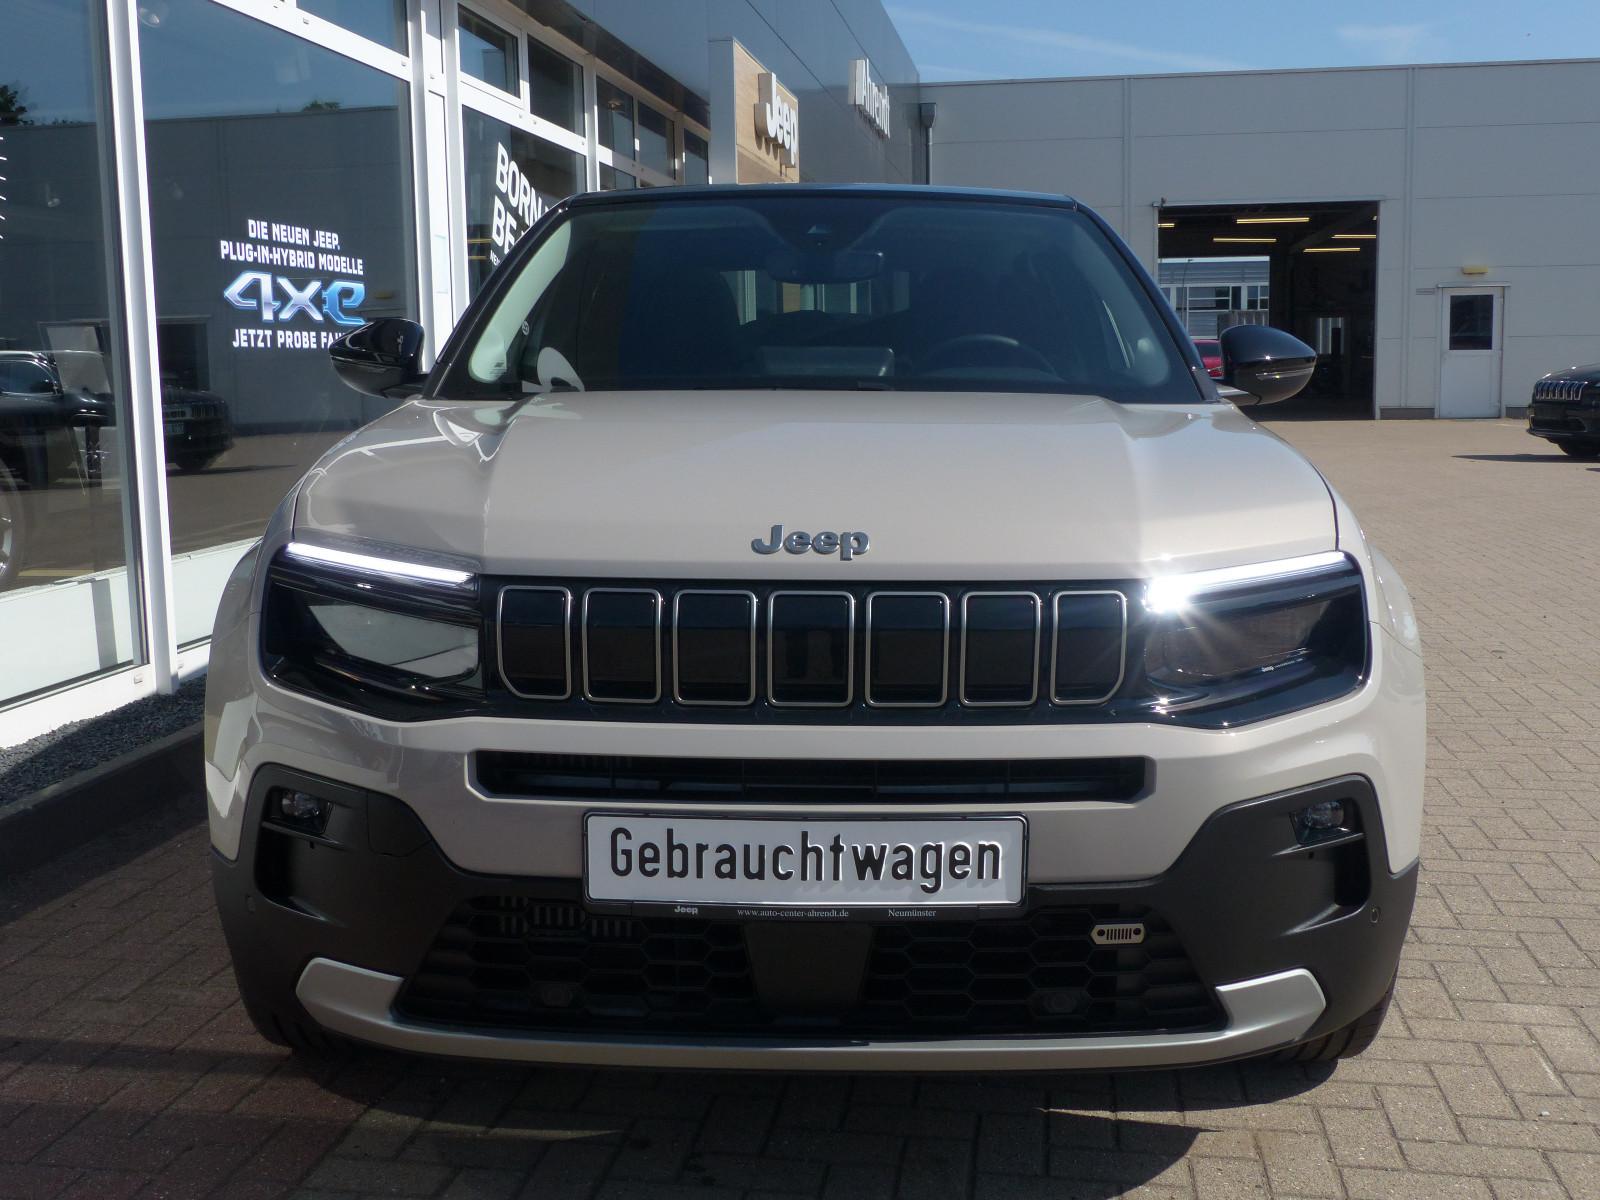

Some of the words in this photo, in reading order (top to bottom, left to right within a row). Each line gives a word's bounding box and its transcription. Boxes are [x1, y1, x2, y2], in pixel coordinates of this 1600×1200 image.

[762, 72, 798, 166] Jeep
[495, 141, 542, 229] BORN
[247, 218, 268, 240] DIE
[271, 222, 310, 246] NEUEN
[220, 240, 315, 269] PLUG-IN-HYBRID
[318, 252, 364, 276] MODELLE
[232, 328, 272, 348] JETZT
[277, 330, 317, 349] PROBE
[750, 524, 870, 561] Jeep
[610, 827, 1002, 894] Gebrauchtwagen
[674, 904, 699, 915] Jeep
[737, 907, 849, 918] www.auto-center-ahrendt.de
[887, 908, 937, 917] Neumünster
